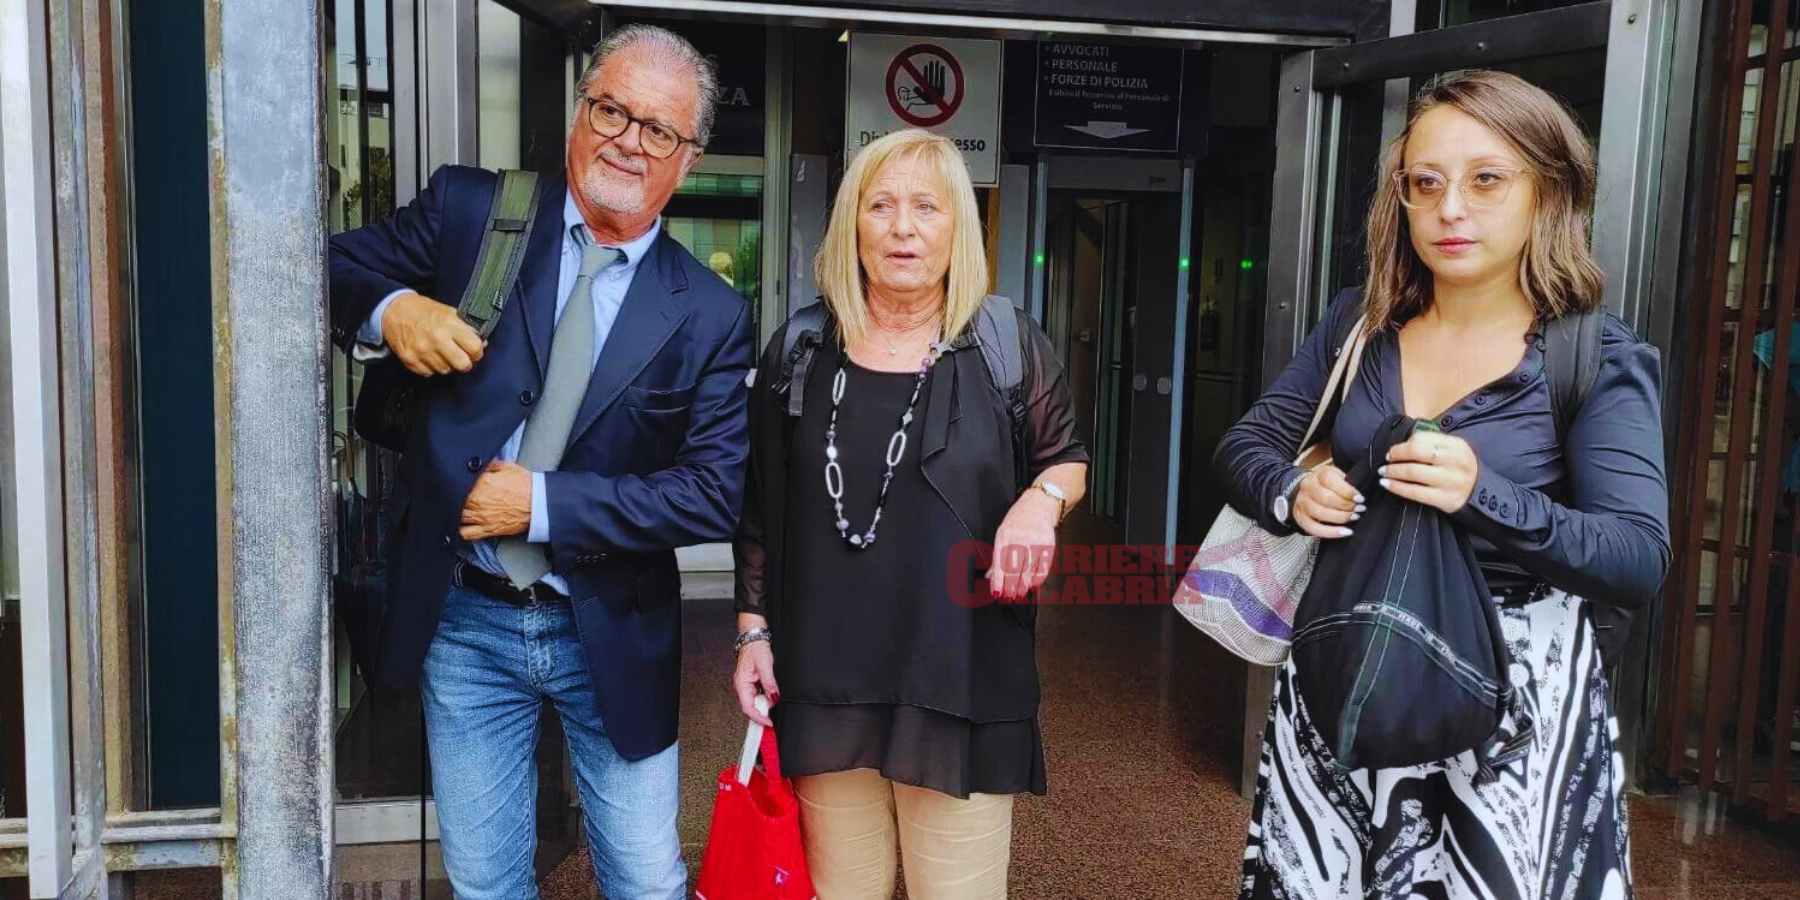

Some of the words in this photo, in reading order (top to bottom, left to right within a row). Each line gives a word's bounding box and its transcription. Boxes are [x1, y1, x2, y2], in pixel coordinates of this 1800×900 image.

[1053, 44, 1109, 57] AVVOCATI
[1052, 59, 1118, 72] PERSONALE
[1051, 74, 1088, 85] FORZE
[1090, 76, 1102, 86] DI
[1105, 77, 1148, 89] POLIZIA
